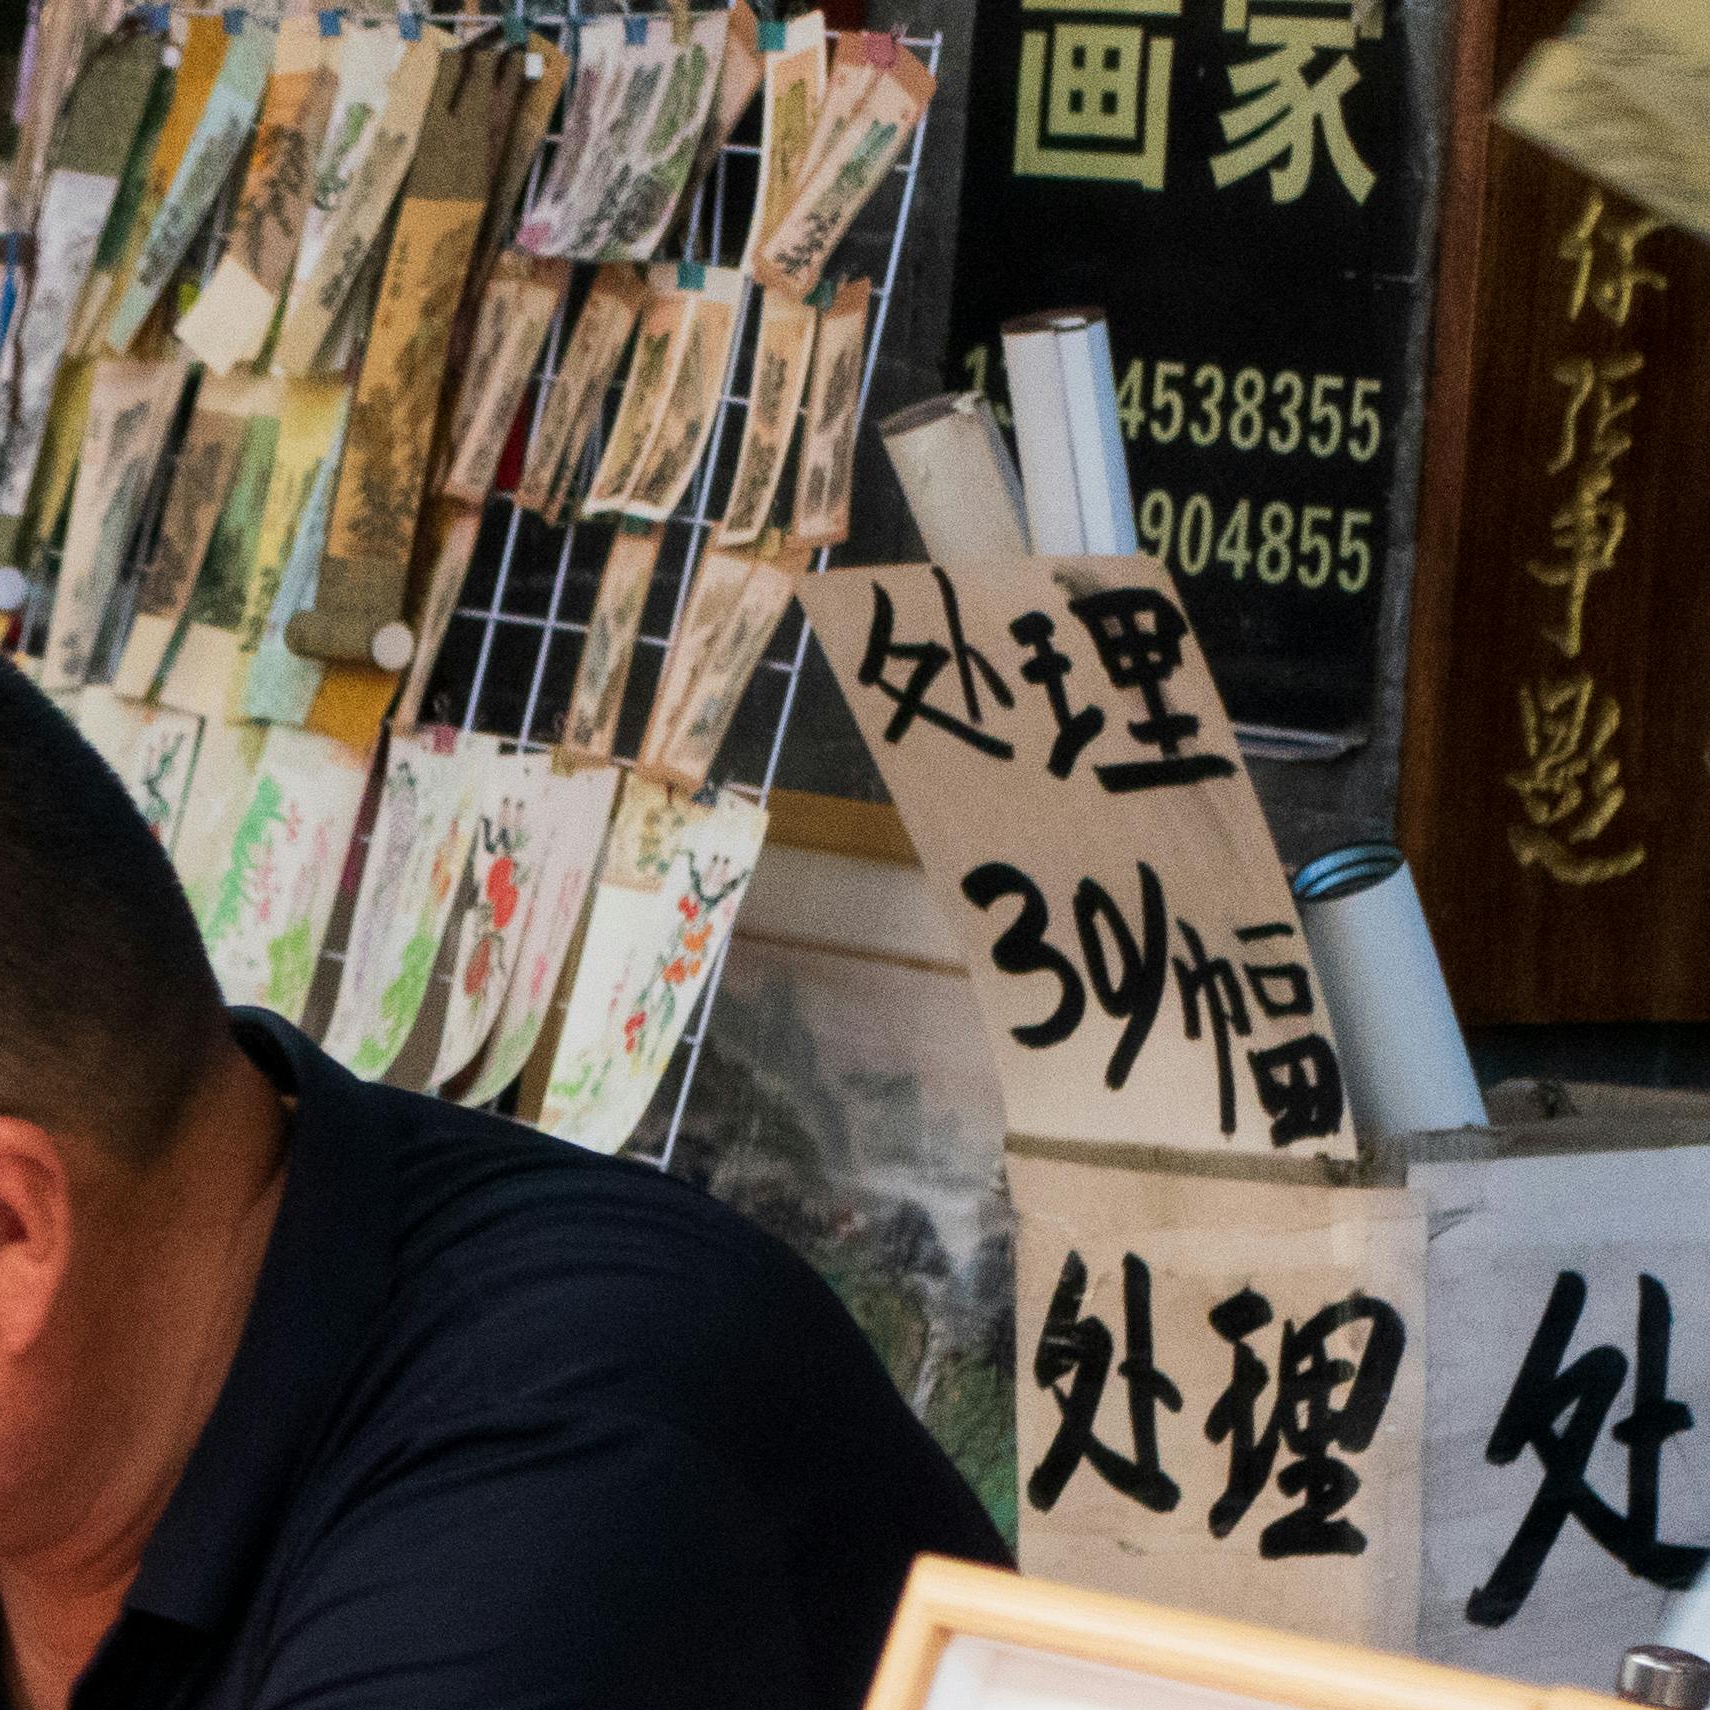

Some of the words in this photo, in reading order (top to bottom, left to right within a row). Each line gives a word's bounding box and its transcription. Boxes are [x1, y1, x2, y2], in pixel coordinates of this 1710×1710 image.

[1013, 0, 1382, 206] 画家
[964, 343, 1382, 462] 14538355
[1141, 488, 1373, 594] 904855
[858, 565, 1236, 793] 处理
[1028, 1250, 1406, 1560] 处理
